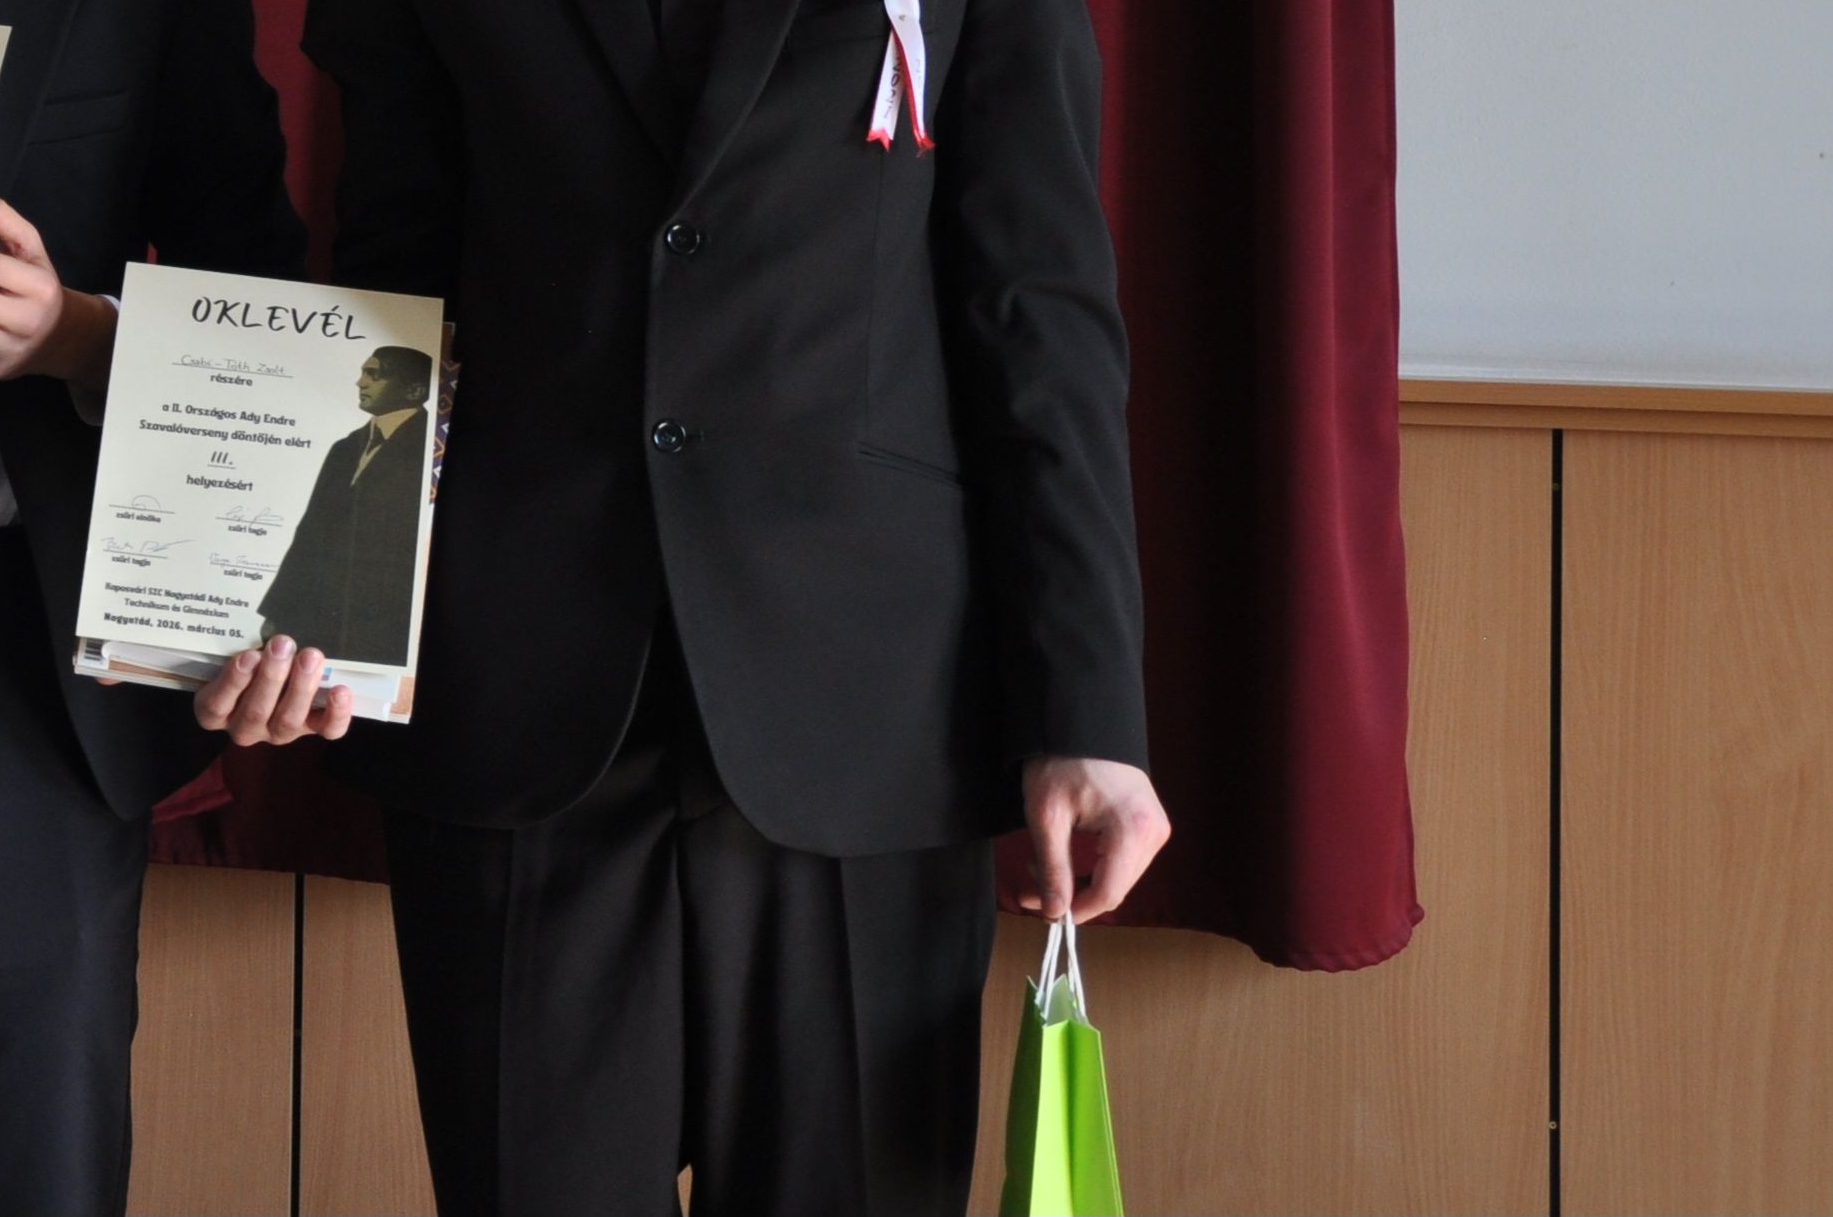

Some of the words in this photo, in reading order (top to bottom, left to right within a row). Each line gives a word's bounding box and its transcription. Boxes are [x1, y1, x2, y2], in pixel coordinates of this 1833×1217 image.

[191, 296, 366, 339] OKLEVÉL
[210, 373, 253, 386] részére
[162, 403, 169, 412] a
[172, 403, 182, 413] II.
[185, 404, 237, 420] Országos
[239, 411, 261, 425] Ady
[263, 413, 296, 427] Endre
[139, 419, 228, 441] Szavalóverseny
[231, 430, 282, 446] döntőjén
[284, 437, 311, 449] elért
[210, 451, 234, 466] III.
[186, 474, 253, 491] helyezésért
[105, 582, 146, 595] Kaposvári
[164, 589, 206, 603] Nagyatádi
[208, 594, 224, 606] Ady
[225, 597, 249, 608] Endre
[124, 597, 170, 611] Technikum
[171, 602, 181, 613] és
[183, 605, 229, 619] Gimnázium
[104, 612, 153, 627] Nagyatád,
[157, 619, 184, 631] 2026.
[187, 624, 226, 636] március
[229, 629, 244, 639] 05.
